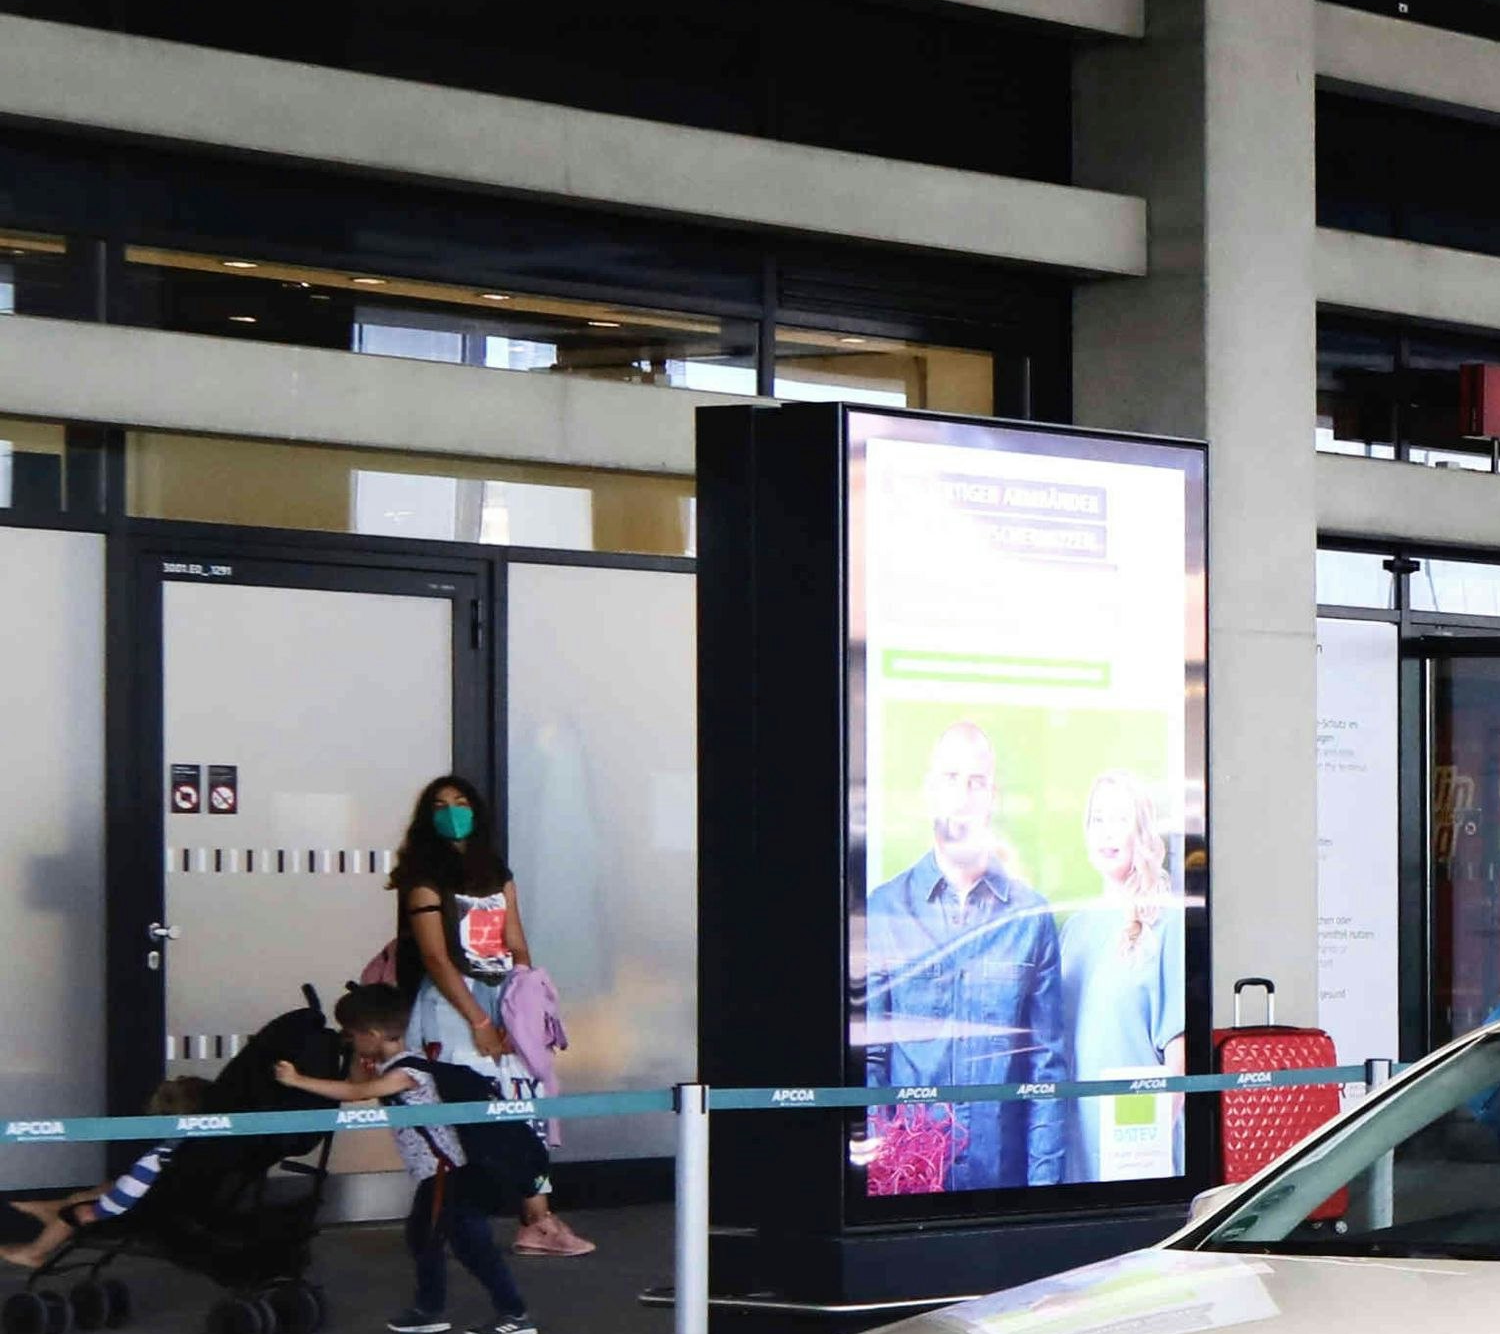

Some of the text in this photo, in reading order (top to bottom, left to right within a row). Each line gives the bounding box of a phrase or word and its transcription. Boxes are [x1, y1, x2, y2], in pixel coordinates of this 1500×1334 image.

[1130, 1078, 1167, 1090] APCOA
[1237, 1072, 1272, 1085] APCOA
[771, 1089, 815, 1102] APCOA
[896, 1087, 938, 1100] APCOA
[1017, 1083, 1056, 1095] APCOA
[486, 1101, 535, 1115] APCOA
[177, 1116, 233, 1130] APCOA
[336, 1109, 388, 1124] APCOA
[5, 1121, 65, 1135] APCOA
